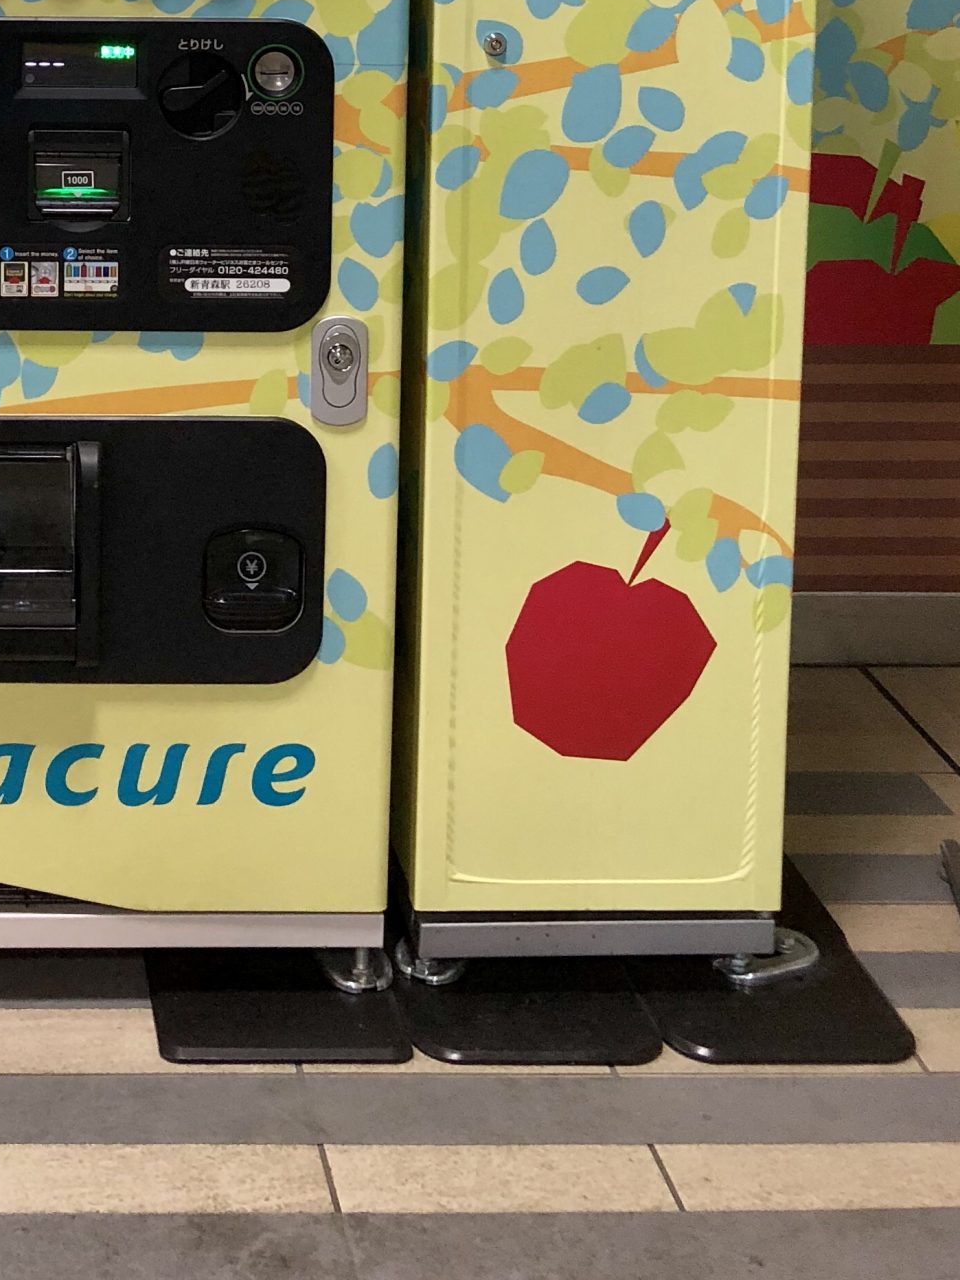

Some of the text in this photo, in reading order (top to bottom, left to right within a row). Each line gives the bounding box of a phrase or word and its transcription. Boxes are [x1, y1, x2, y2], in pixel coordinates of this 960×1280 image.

[178, 39, 224, 50] とりけし
[66, 176, 88, 184] 1000
[67, 249, 74, 259] 2
[191, 280, 230, 289] 新青森駅
[236, 280, 270, 288] 26208
